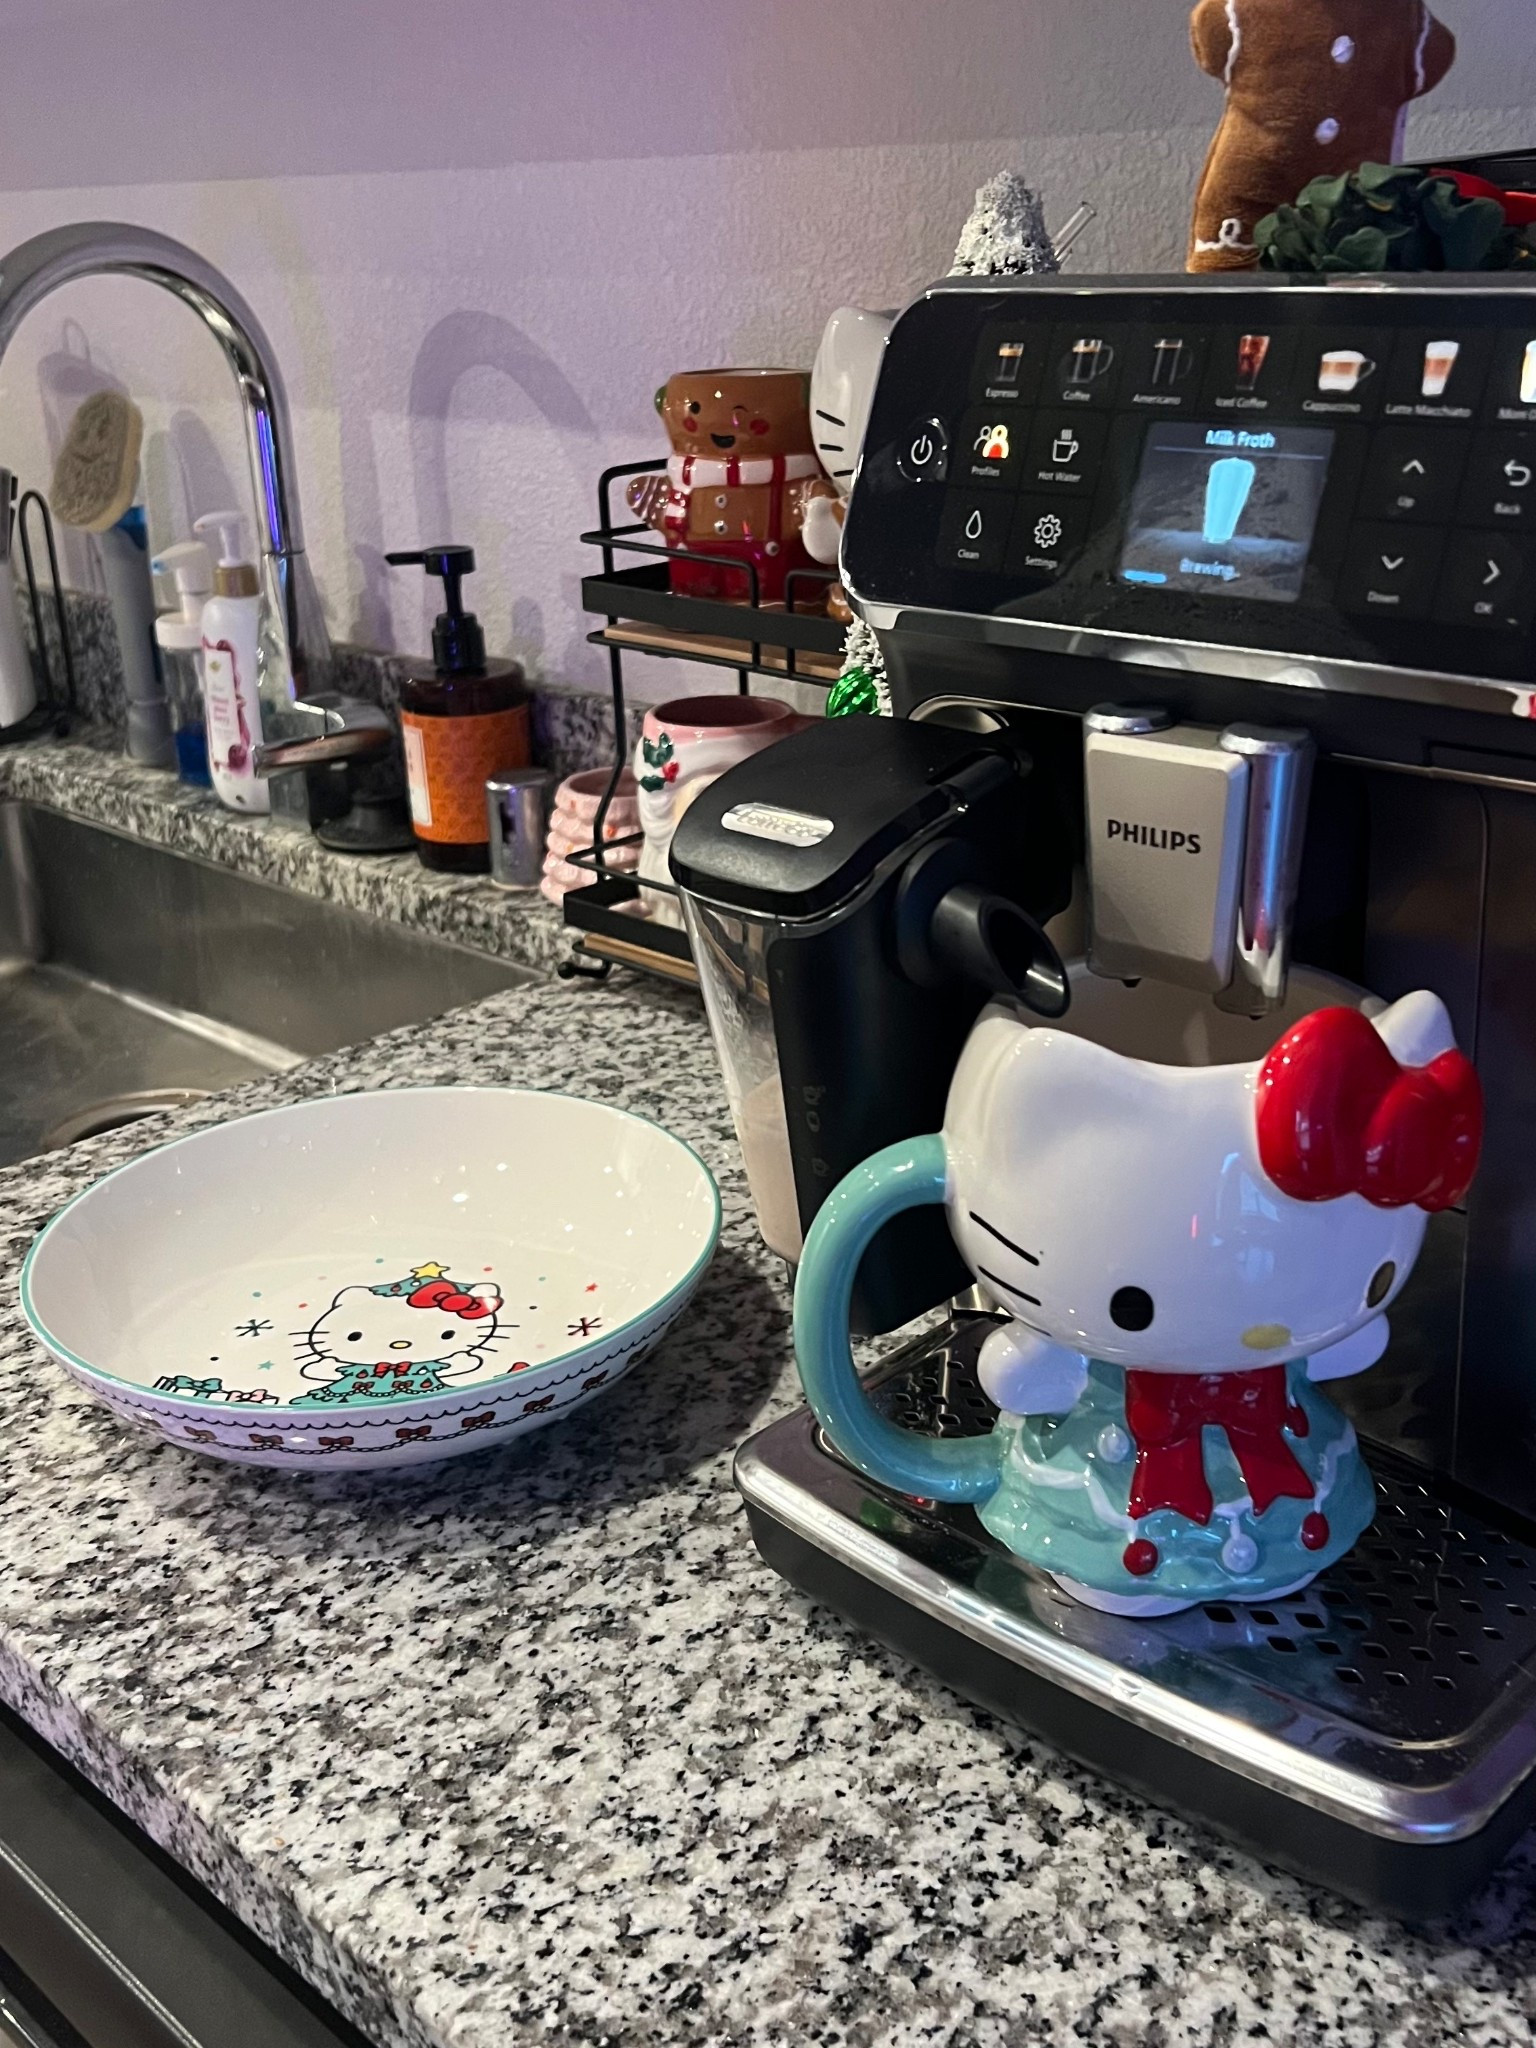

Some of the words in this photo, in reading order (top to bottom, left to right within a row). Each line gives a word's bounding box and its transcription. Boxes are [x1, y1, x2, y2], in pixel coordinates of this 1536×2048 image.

[1206, 429, 1235, 446] Milk
[1237, 431, 1276, 448] Froth
[1107, 819, 1201, 854] PHILIPS
